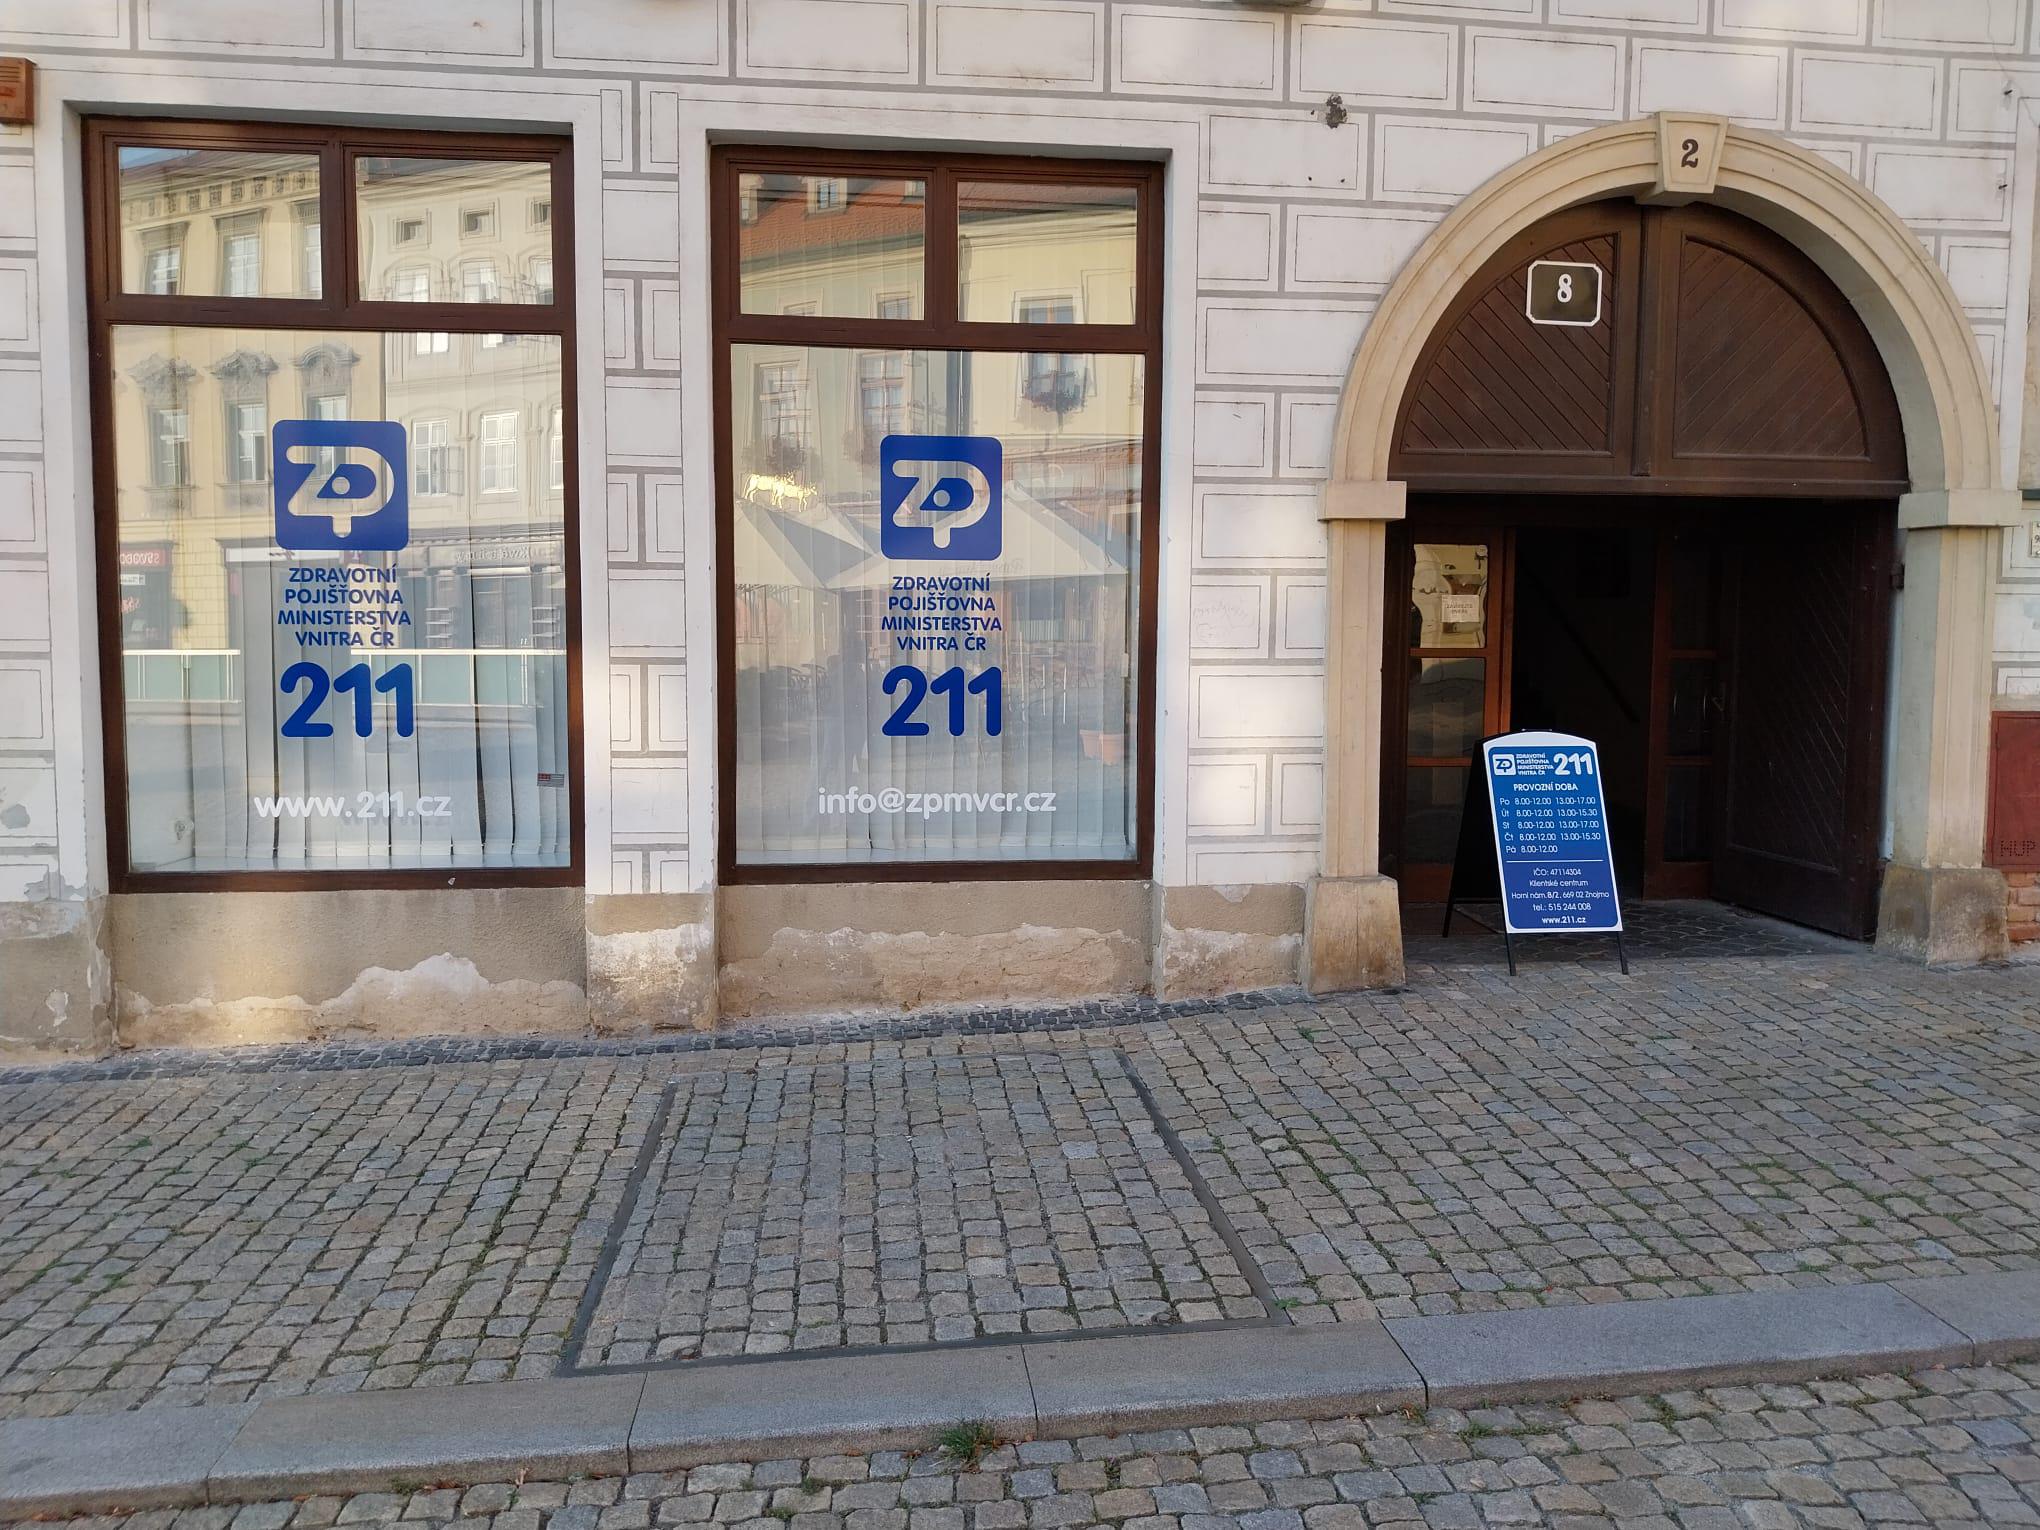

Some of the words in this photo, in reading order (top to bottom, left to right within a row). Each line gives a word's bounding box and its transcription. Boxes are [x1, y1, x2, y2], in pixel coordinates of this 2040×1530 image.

[1681, 139, 1699, 168] 2
[1557, 273, 1572, 303] 8
[289, 564, 397, 583] ZDRAVOTNÍ
[892, 572, 991, 592] ZDRAVOTNÍ
[285, 584, 403, 604] POJIŠŤOVNA
[888, 592, 996, 612] POJIŠŤOVNA
[278, 610, 411, 626] MINISTERSTVA
[881, 616, 1002, 632] MINISTERSTVA
[295, 631, 363, 646] VNITRA
[370, 627, 394, 647] ČR
[897, 636, 958, 652] VNITRA
[964, 631, 987, 651] ČR
[280, 661, 414, 738] 211
[882, 665, 1002, 738] 211
[1553, 752, 1593, 775] 211
[1513, 782, 1554, 791] PROVOZNÍ
[1555, 783, 1579, 791] DOBA
[254, 790, 453, 819] www.211.cz
[818, 786, 1057, 819] info@zpmvcr.cz
[1500, 797, 1510, 806] Po
[1514, 797, 1551, 805] 8.00-12.00
[1556, 797, 1596, 805] 13.00-17.00
[1501, 808, 1510, 817] Út
[1516, 809, 1553, 817] 8.00-12.00
[1557, 808, 1598, 817] 13.00-15.30
[1503, 821, 1510, 829] St
[1517, 821, 1555, 829] 8.00-12.00
[1559, 821, 1599, 829] 13.00-17.00
[1504, 832, 1514, 841] Čt
[1519, 833, 1556, 841] 8.00-12.00
[1560, 832, 1601, 841] 13.00-15.30
[1521, 845, 1558, 853] 8.00-12.00
[2001, 840, 2037, 857] HUP
[1550, 868, 1581, 876] 47114304
[1529, 879, 1559, 887] Klientské
[1563, 891, 1574, 899] 669
[1585, 890, 1610, 900] Znojmo
[1548, 903, 1561, 911] 515
[1563, 903, 1576, 911] 244
[1577, 903, 1591, 911] 008
[1541, 915, 1586, 924] www.211.cz
